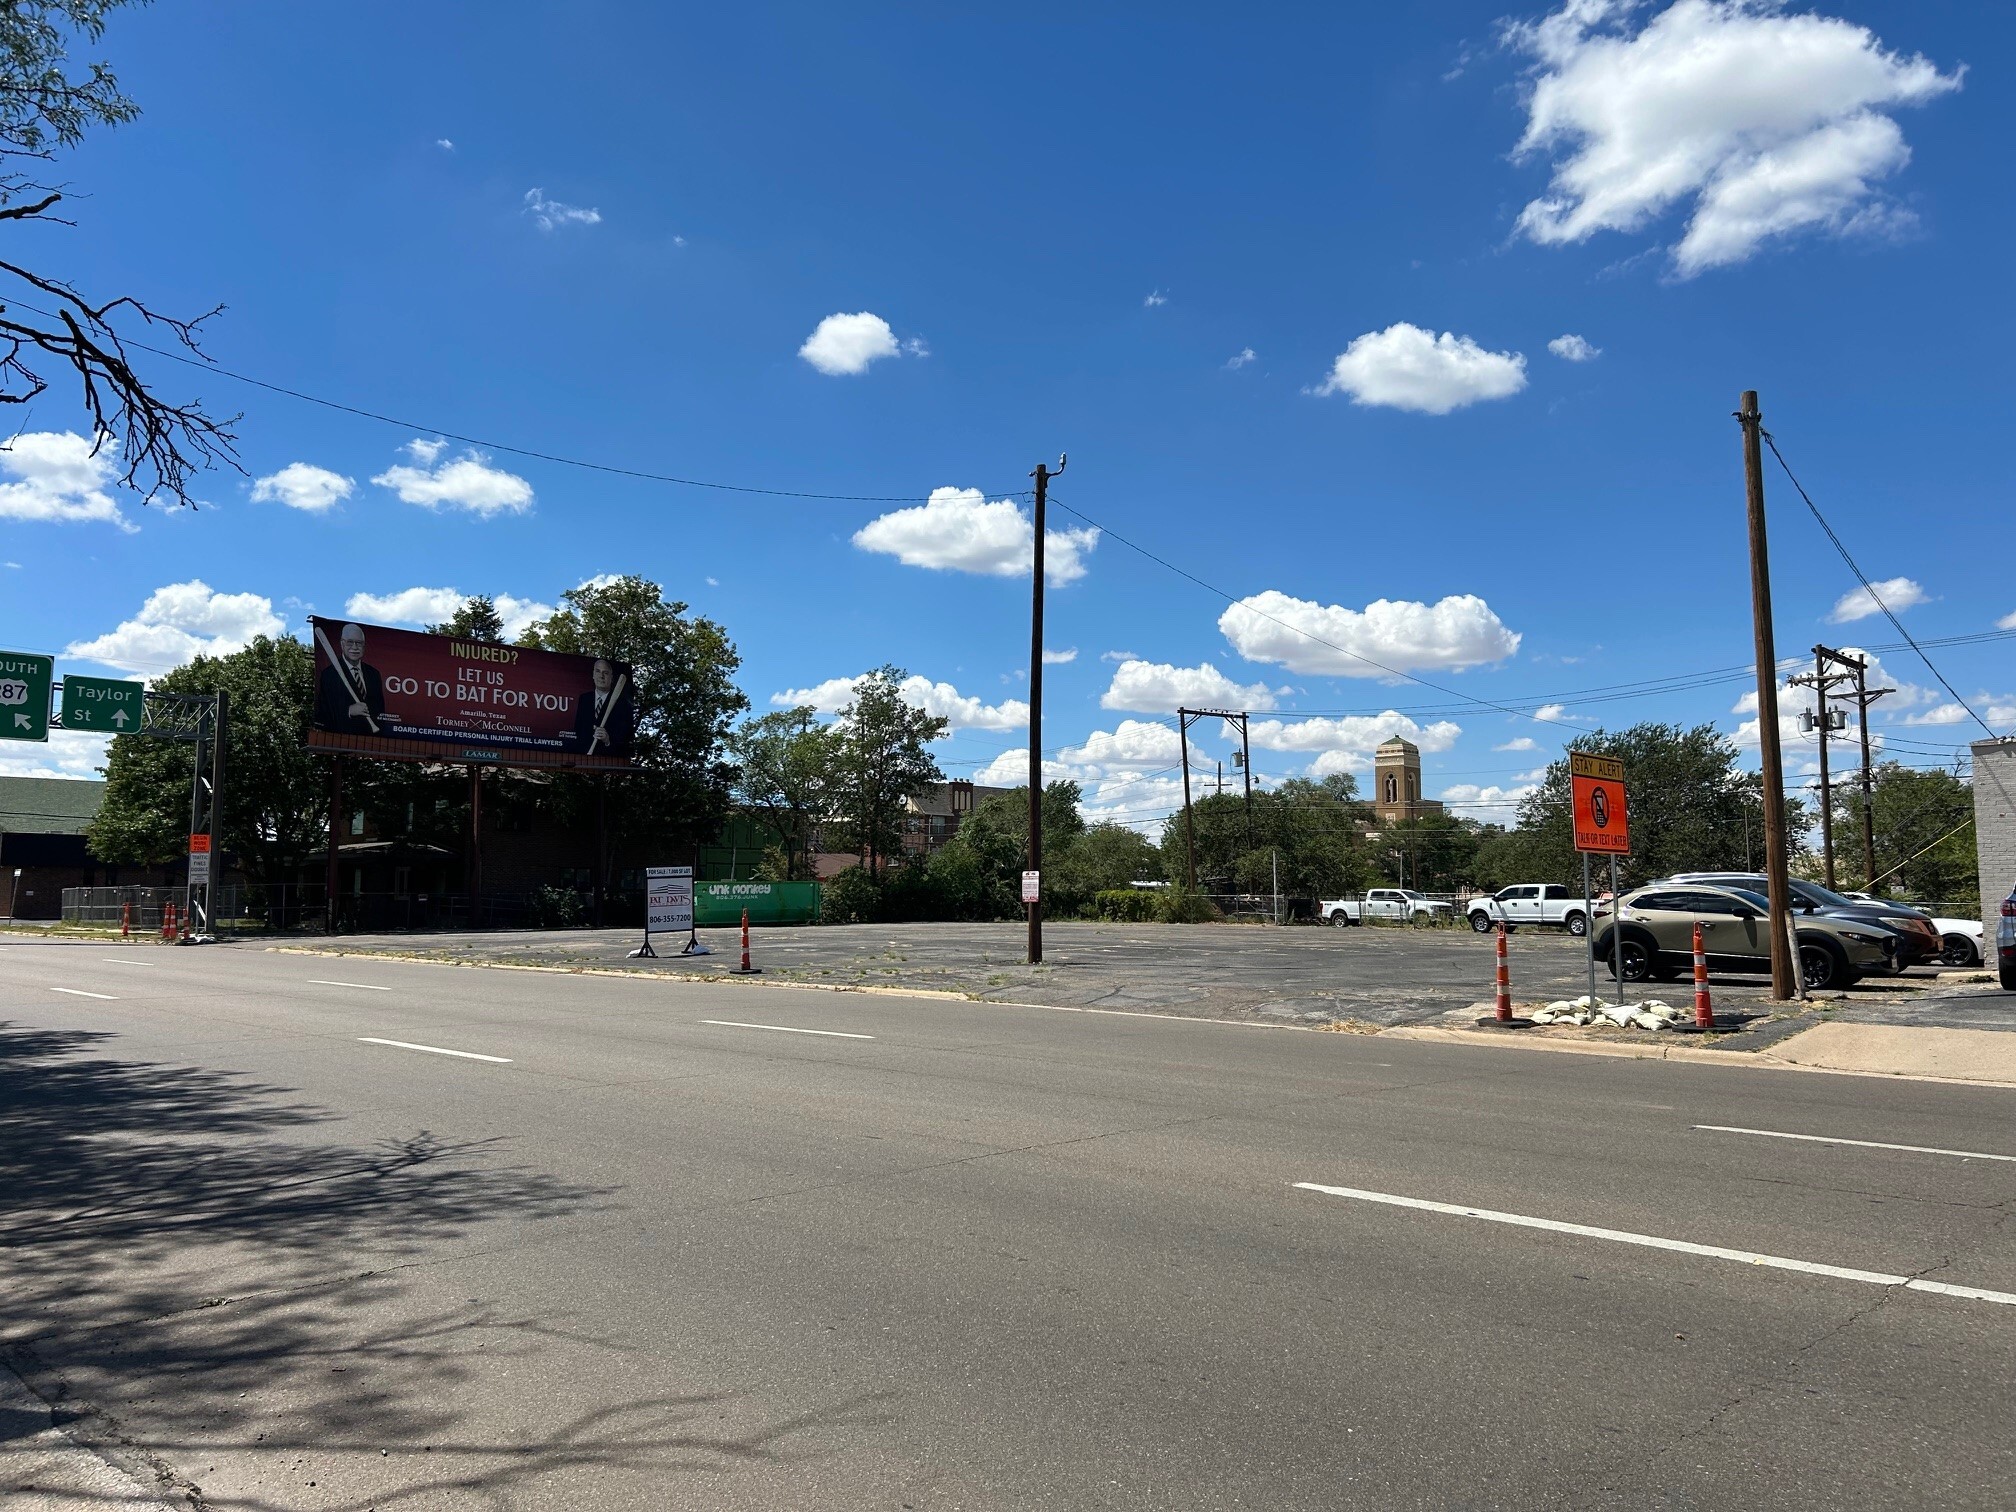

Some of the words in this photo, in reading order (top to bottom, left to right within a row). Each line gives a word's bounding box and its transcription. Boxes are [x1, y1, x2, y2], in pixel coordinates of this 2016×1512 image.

[450, 642, 519, 665] INJURED?
[458, 667, 482, 682] LET
[486, 671, 504, 686] US
[0, 684, 26, 700] 87
[76, 685, 132, 702] Taylor
[385, 676, 418, 695] GO
[424, 680, 450, 698] TO
[456, 684, 488, 702] BAT
[492, 688, 528, 708] FOR
[74, 708, 92, 722] St
[460, 709, 487, 718] Amarillo,
[436, 716, 470, 728] TORMEY
[392, 726, 418, 734] BOARD
[418, 728, 453, 737] CERTIFIED
[454, 731, 489, 740] PERSONAL
[490, 734, 514, 742] INJURY
[534, 738, 564, 746] LAWYERS
[465, 750, 498, 759] LAMAR
[1575, 758, 1593, 773] STAY
[1598, 762, 1620, 778] ALERT
[1578, 832, 1590, 844] TALK
[1591, 832, 1598, 844] OR
[1599, 834, 1610, 845] TEXT
[1611, 834, 1627, 846] LATER
[666, 894, 691, 905] DAVIS
[650, 914, 691, 923] 806-355-7200
